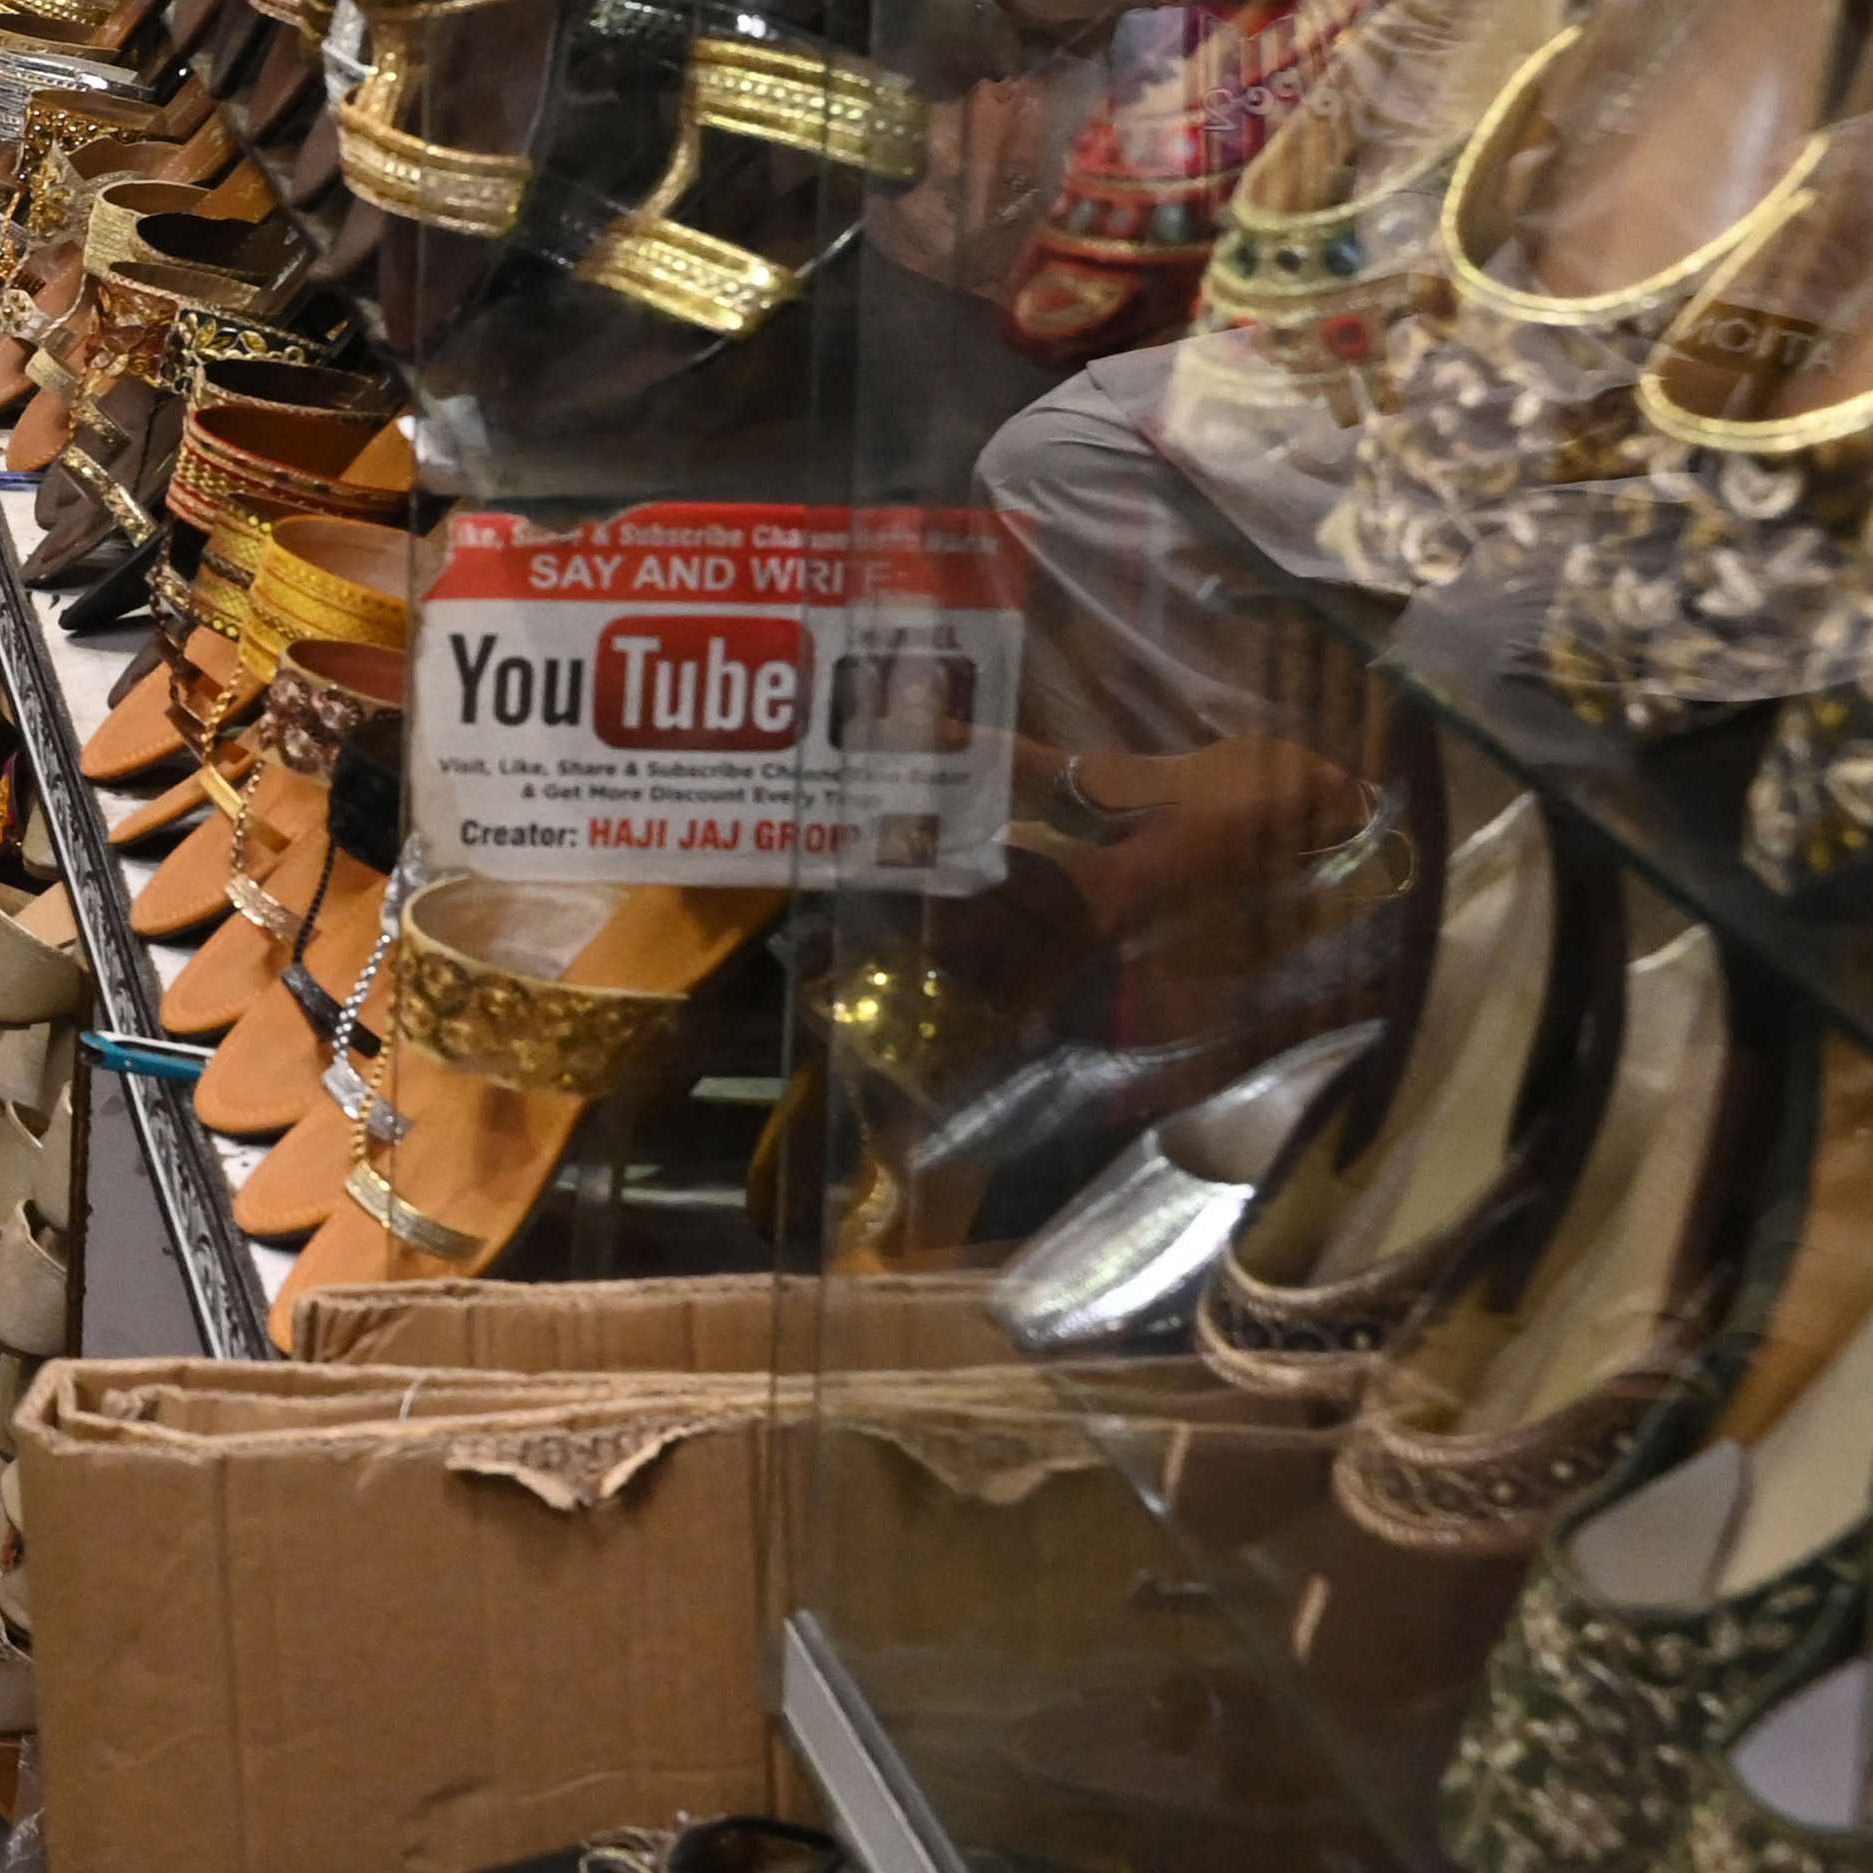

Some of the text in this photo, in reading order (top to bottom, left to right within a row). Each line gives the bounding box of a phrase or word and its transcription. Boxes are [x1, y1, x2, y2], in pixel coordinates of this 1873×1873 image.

[529, 554, 891, 594] SAY AND WRIE
[558, 759, 617, 776] Share
[647, 760, 753, 779] Subscribe
[542, 783, 581, 801] Get
[588, 784, 642, 801] More
[650, 784, 746, 803] Discount
[459, 819, 578, 848] Creator:
[588, 817, 669, 849] HAJI
[678, 818, 742, 852] JAJ
